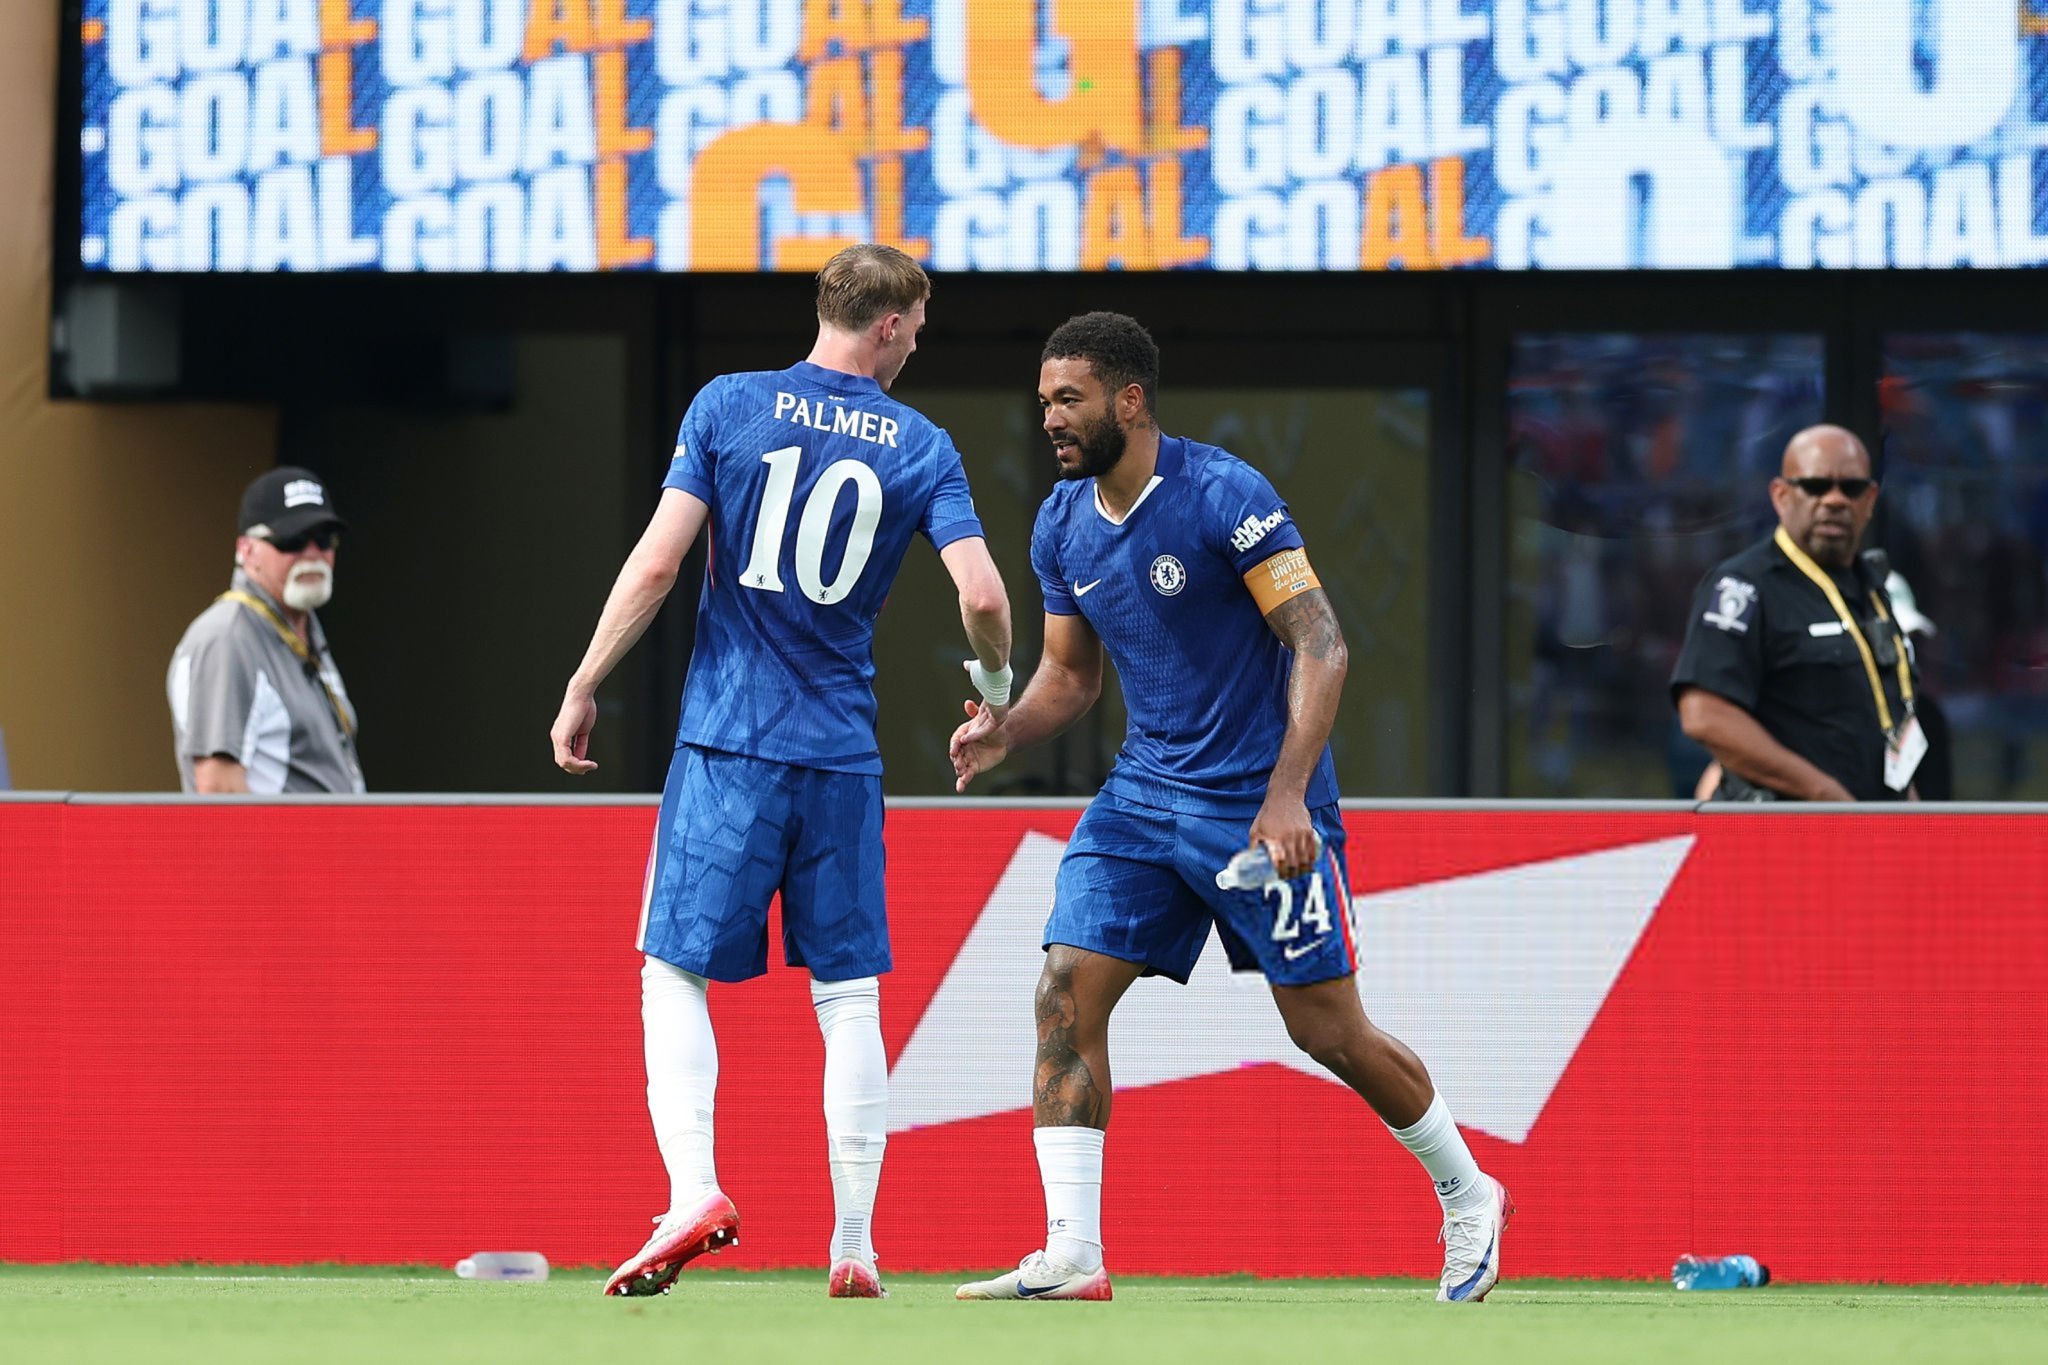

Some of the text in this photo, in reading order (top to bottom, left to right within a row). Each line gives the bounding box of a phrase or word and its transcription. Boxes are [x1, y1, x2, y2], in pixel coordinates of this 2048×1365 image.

[108, 50, 378, 198] GOAL
[380, 50, 654, 198] GOAL
[1211, 45, 1490, 195] GOAL
[108, 157, 378, 271] GOAL
[380, 156, 654, 271] GOAL
[931, 156, 1211, 271] GOAL
[1211, 156, 1491, 270] GOAL
[773, 391, 899, 448] PALMER
[739, 445, 883, 605] 10
[1230, 514, 1261, 545] LIVE
[1235, 508, 1285, 553] NATION
[1271, 556, 1309, 580] UNITES
[1264, 872, 1333, 940] 24
